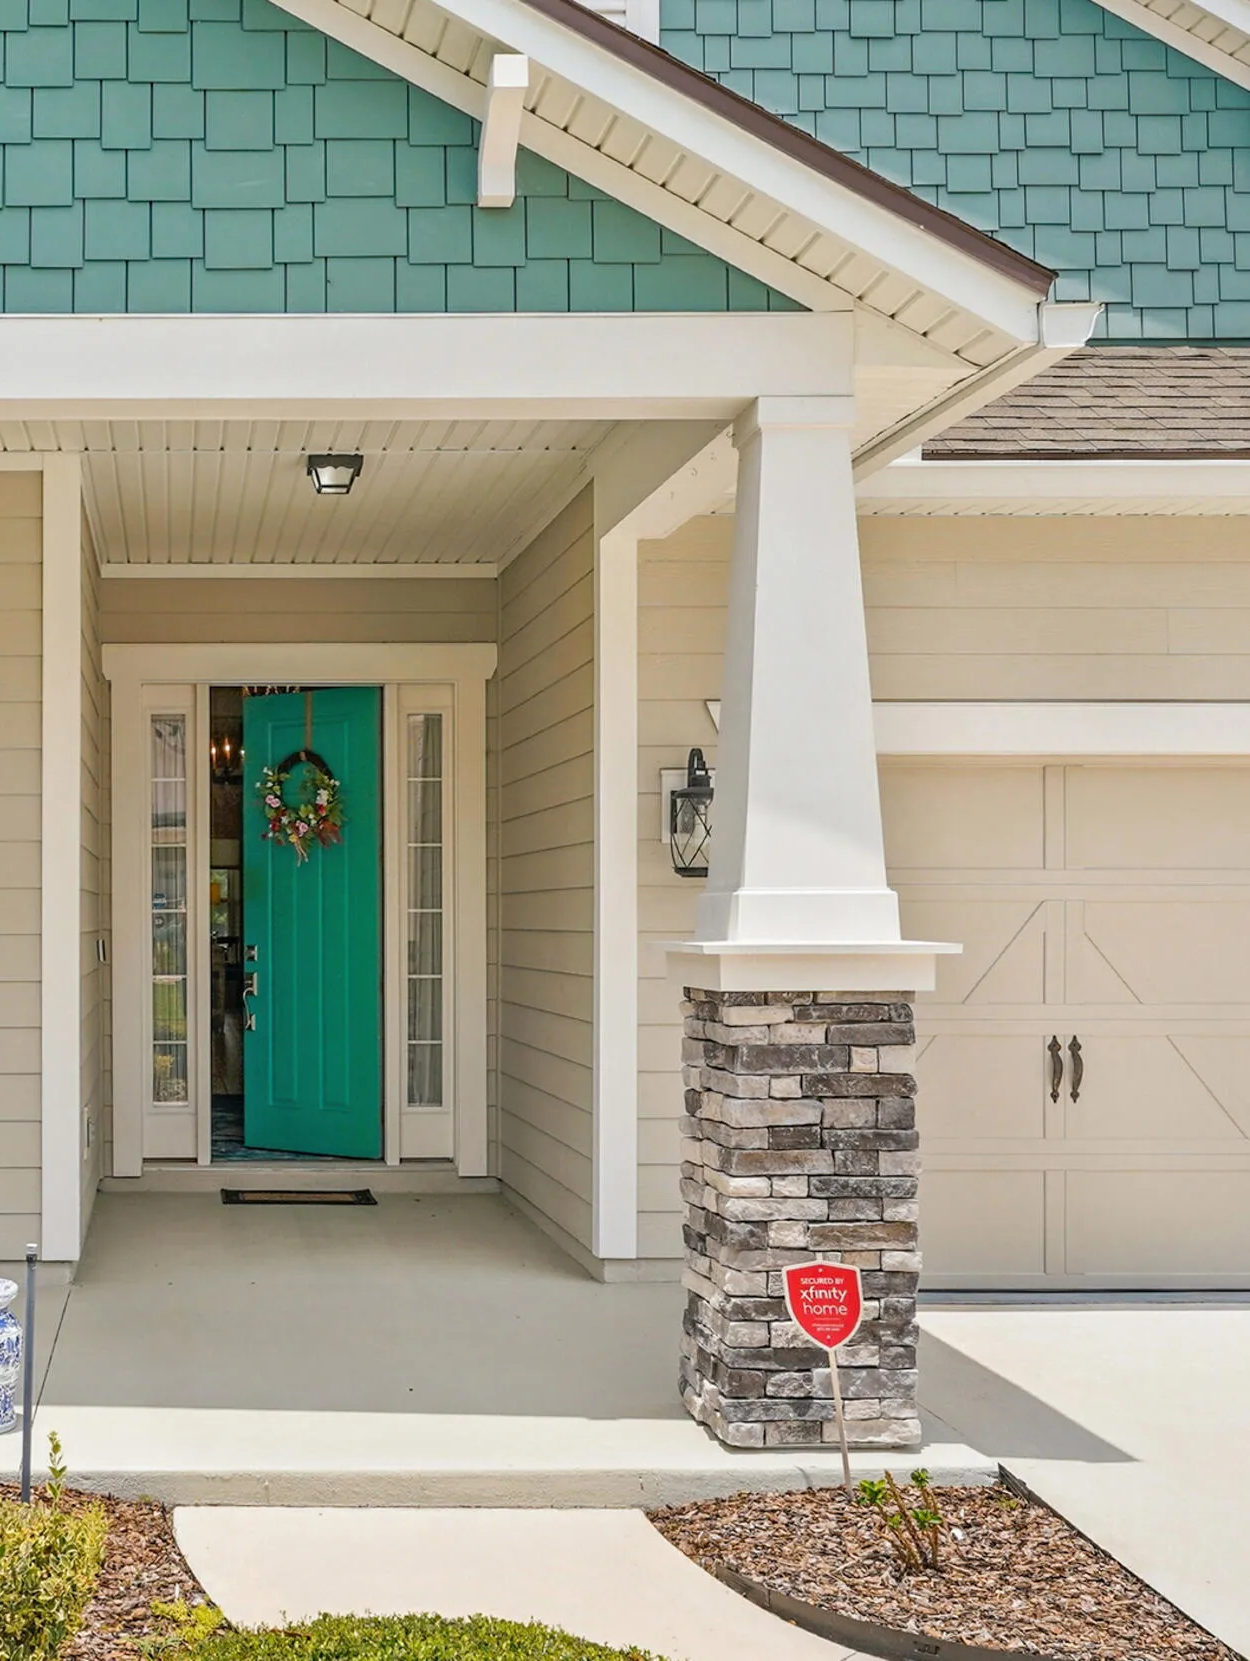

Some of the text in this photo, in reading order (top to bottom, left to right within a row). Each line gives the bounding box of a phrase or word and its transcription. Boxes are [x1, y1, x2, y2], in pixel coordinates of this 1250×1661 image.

[800, 1277, 844, 1285] SECURED BY
[800, 1285, 847, 1303] xfinity
[802, 1301, 848, 1316] home
